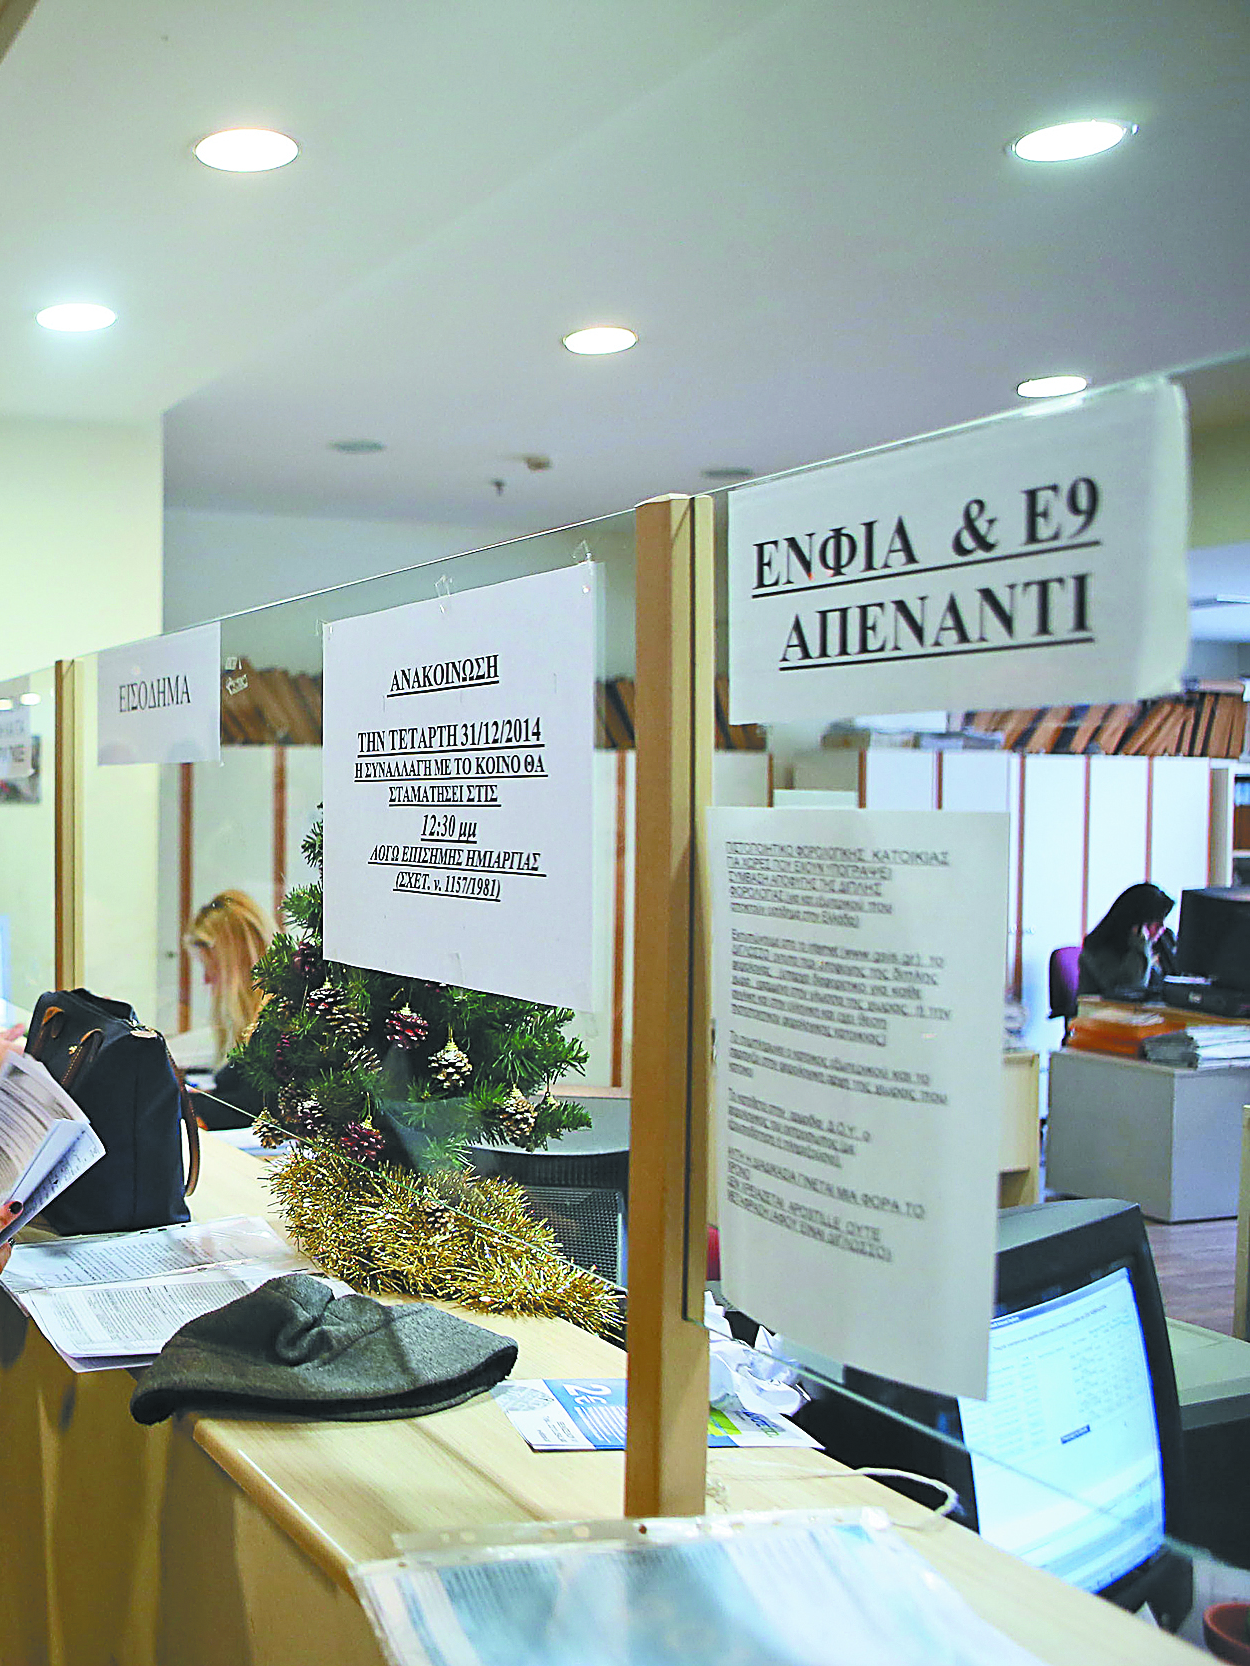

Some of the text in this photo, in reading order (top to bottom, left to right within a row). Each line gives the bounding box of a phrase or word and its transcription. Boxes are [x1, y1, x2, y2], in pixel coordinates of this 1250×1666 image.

[752, 477, 1100, 590] ΕΝΦΙΑ & Ε9
[780, 573, 1093, 663] ΑΠΕΝΑΝΤΙ
[390, 654, 499, 692] ΑΝΑΚΟΙΝΩΣΗ
[119, 674, 192, 713] ΕΙΣΟΔΗΜΑ
[357, 716, 541, 752] ΤΗΝ ΤΕΤΑΡΤΗ 31/12/2014
[355, 753, 545, 778] Η ΣΥΝΑΛΛΑΓΗ ΜΕ ΤΟ ΚΟΙΝΟ ΘΑ
[388, 784, 498, 803] ΣΤΑΜΑΤΗΣΕΙ ΣΤΙΣ
[421, 814, 477, 841] 12:30 μμ
[369, 844, 541, 871] ΛΟΓΩ ΕΠΙΣΗΜΗΣ ΗΜΙΑΡΓΙΑΣ
[872, 848, 948, 866] ΚΑΤΟΙΚΙΑΣ
[395, 871, 431, 890] (ΣΧΕΤ.
[444, 875, 501, 898] 1157/1981)
